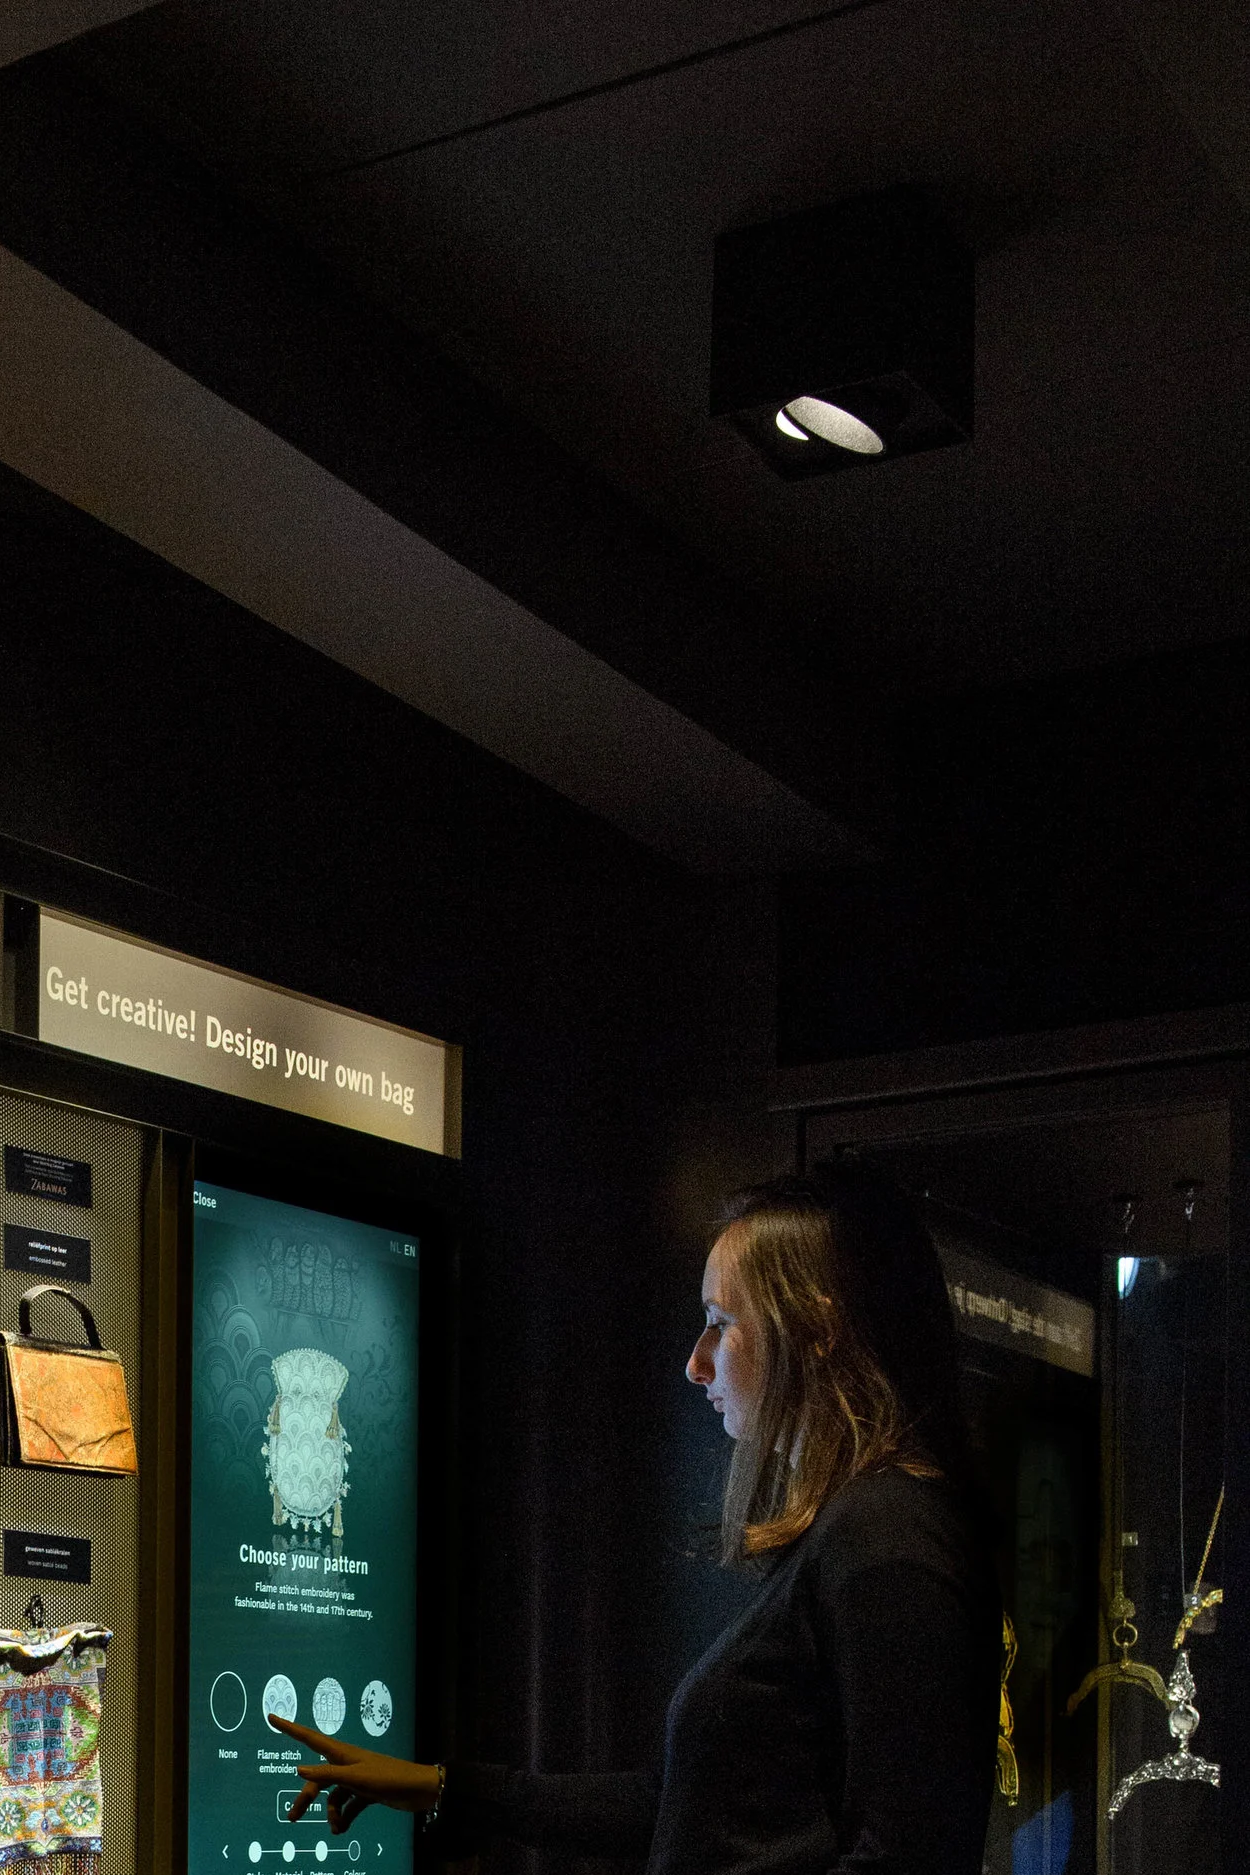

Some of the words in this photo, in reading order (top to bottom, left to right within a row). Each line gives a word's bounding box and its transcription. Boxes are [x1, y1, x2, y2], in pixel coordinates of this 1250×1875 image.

[46, 966, 89, 1009] Get
[97, 989, 196, 1042] creative!
[206, 1015, 277, 1069] Design
[285, 1046, 328, 1082] your
[335, 1062, 373, 1097] own
[381, 1071, 414, 1115] bag
[193, 1191, 216, 1208] Close
[404, 1244, 416, 1257] EN
[239, 1544, 287, 1566] Choose
[291, 1553, 319, 1571] your
[324, 1555, 368, 1575] pattern
[255, 1581, 277, 1593] Flame
[278, 1584, 299, 1595] stitch
[301, 1587, 340, 1601] embroidery
[341, 1591, 355, 1601] was
[234, 1596, 276, 1610] fashionable
[278, 1600, 285, 1611] in
[286, 1601, 298, 1612] the
[299, 1603, 315, 1614] 14th
[316, 1604, 329, 1615] and
[331, 1605, 345, 1617] 17th
[346, 1608, 374, 1621] century.
[1191, 1596, 1199, 1606] 2
[218, 1749, 238, 1759] None
[257, 1749, 280, 1760] Flame
[281, 1750, 302, 1761] stitch
